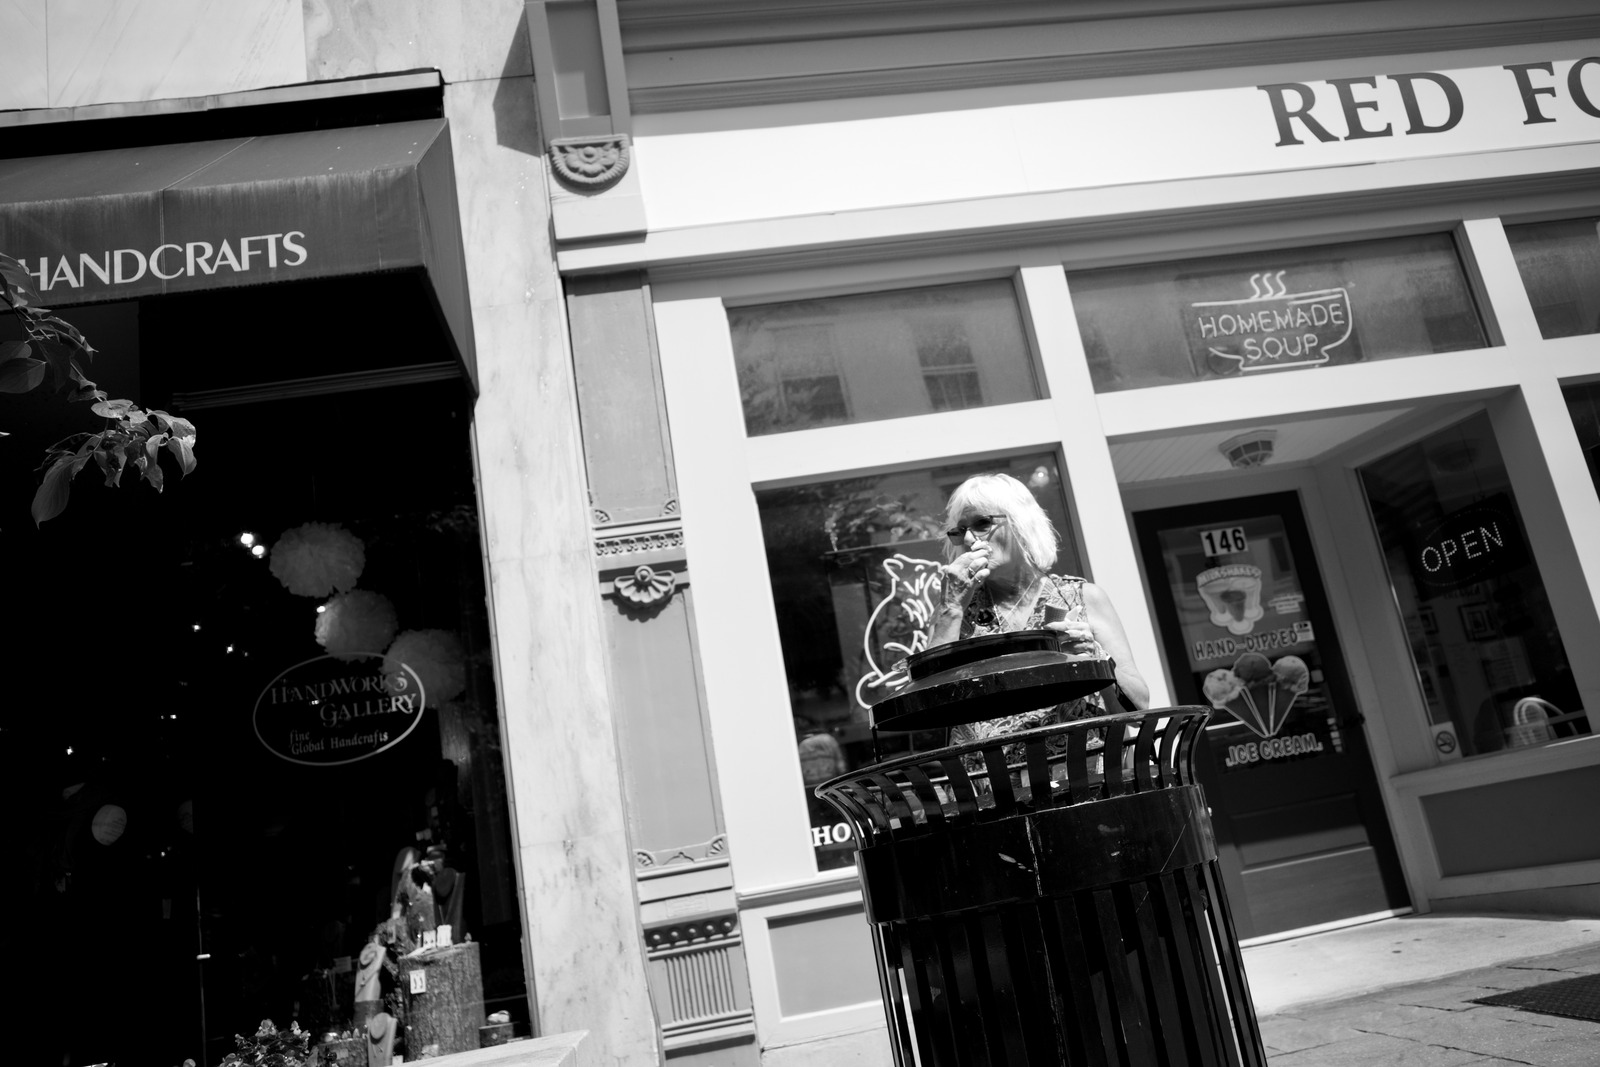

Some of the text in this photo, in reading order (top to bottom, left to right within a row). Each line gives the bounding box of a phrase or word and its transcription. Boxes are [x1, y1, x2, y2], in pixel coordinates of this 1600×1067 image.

[1257, 72, 1464, 147] RED
[17, 231, 308, 294] HANDCRAFTS
[1198, 303, 1345, 338] HOMEMADE
[1244, 333, 1318, 360] SOUP
[1205, 529, 1245, 555] 146
[1421, 521, 1504, 573] OPEN
[320, 693, 417, 728] GALLERY
[291, 729, 389, 755] Global Handcrafts
[1228, 733, 1317, 764] ICE CREAM
[810, 822, 856, 847] HO
